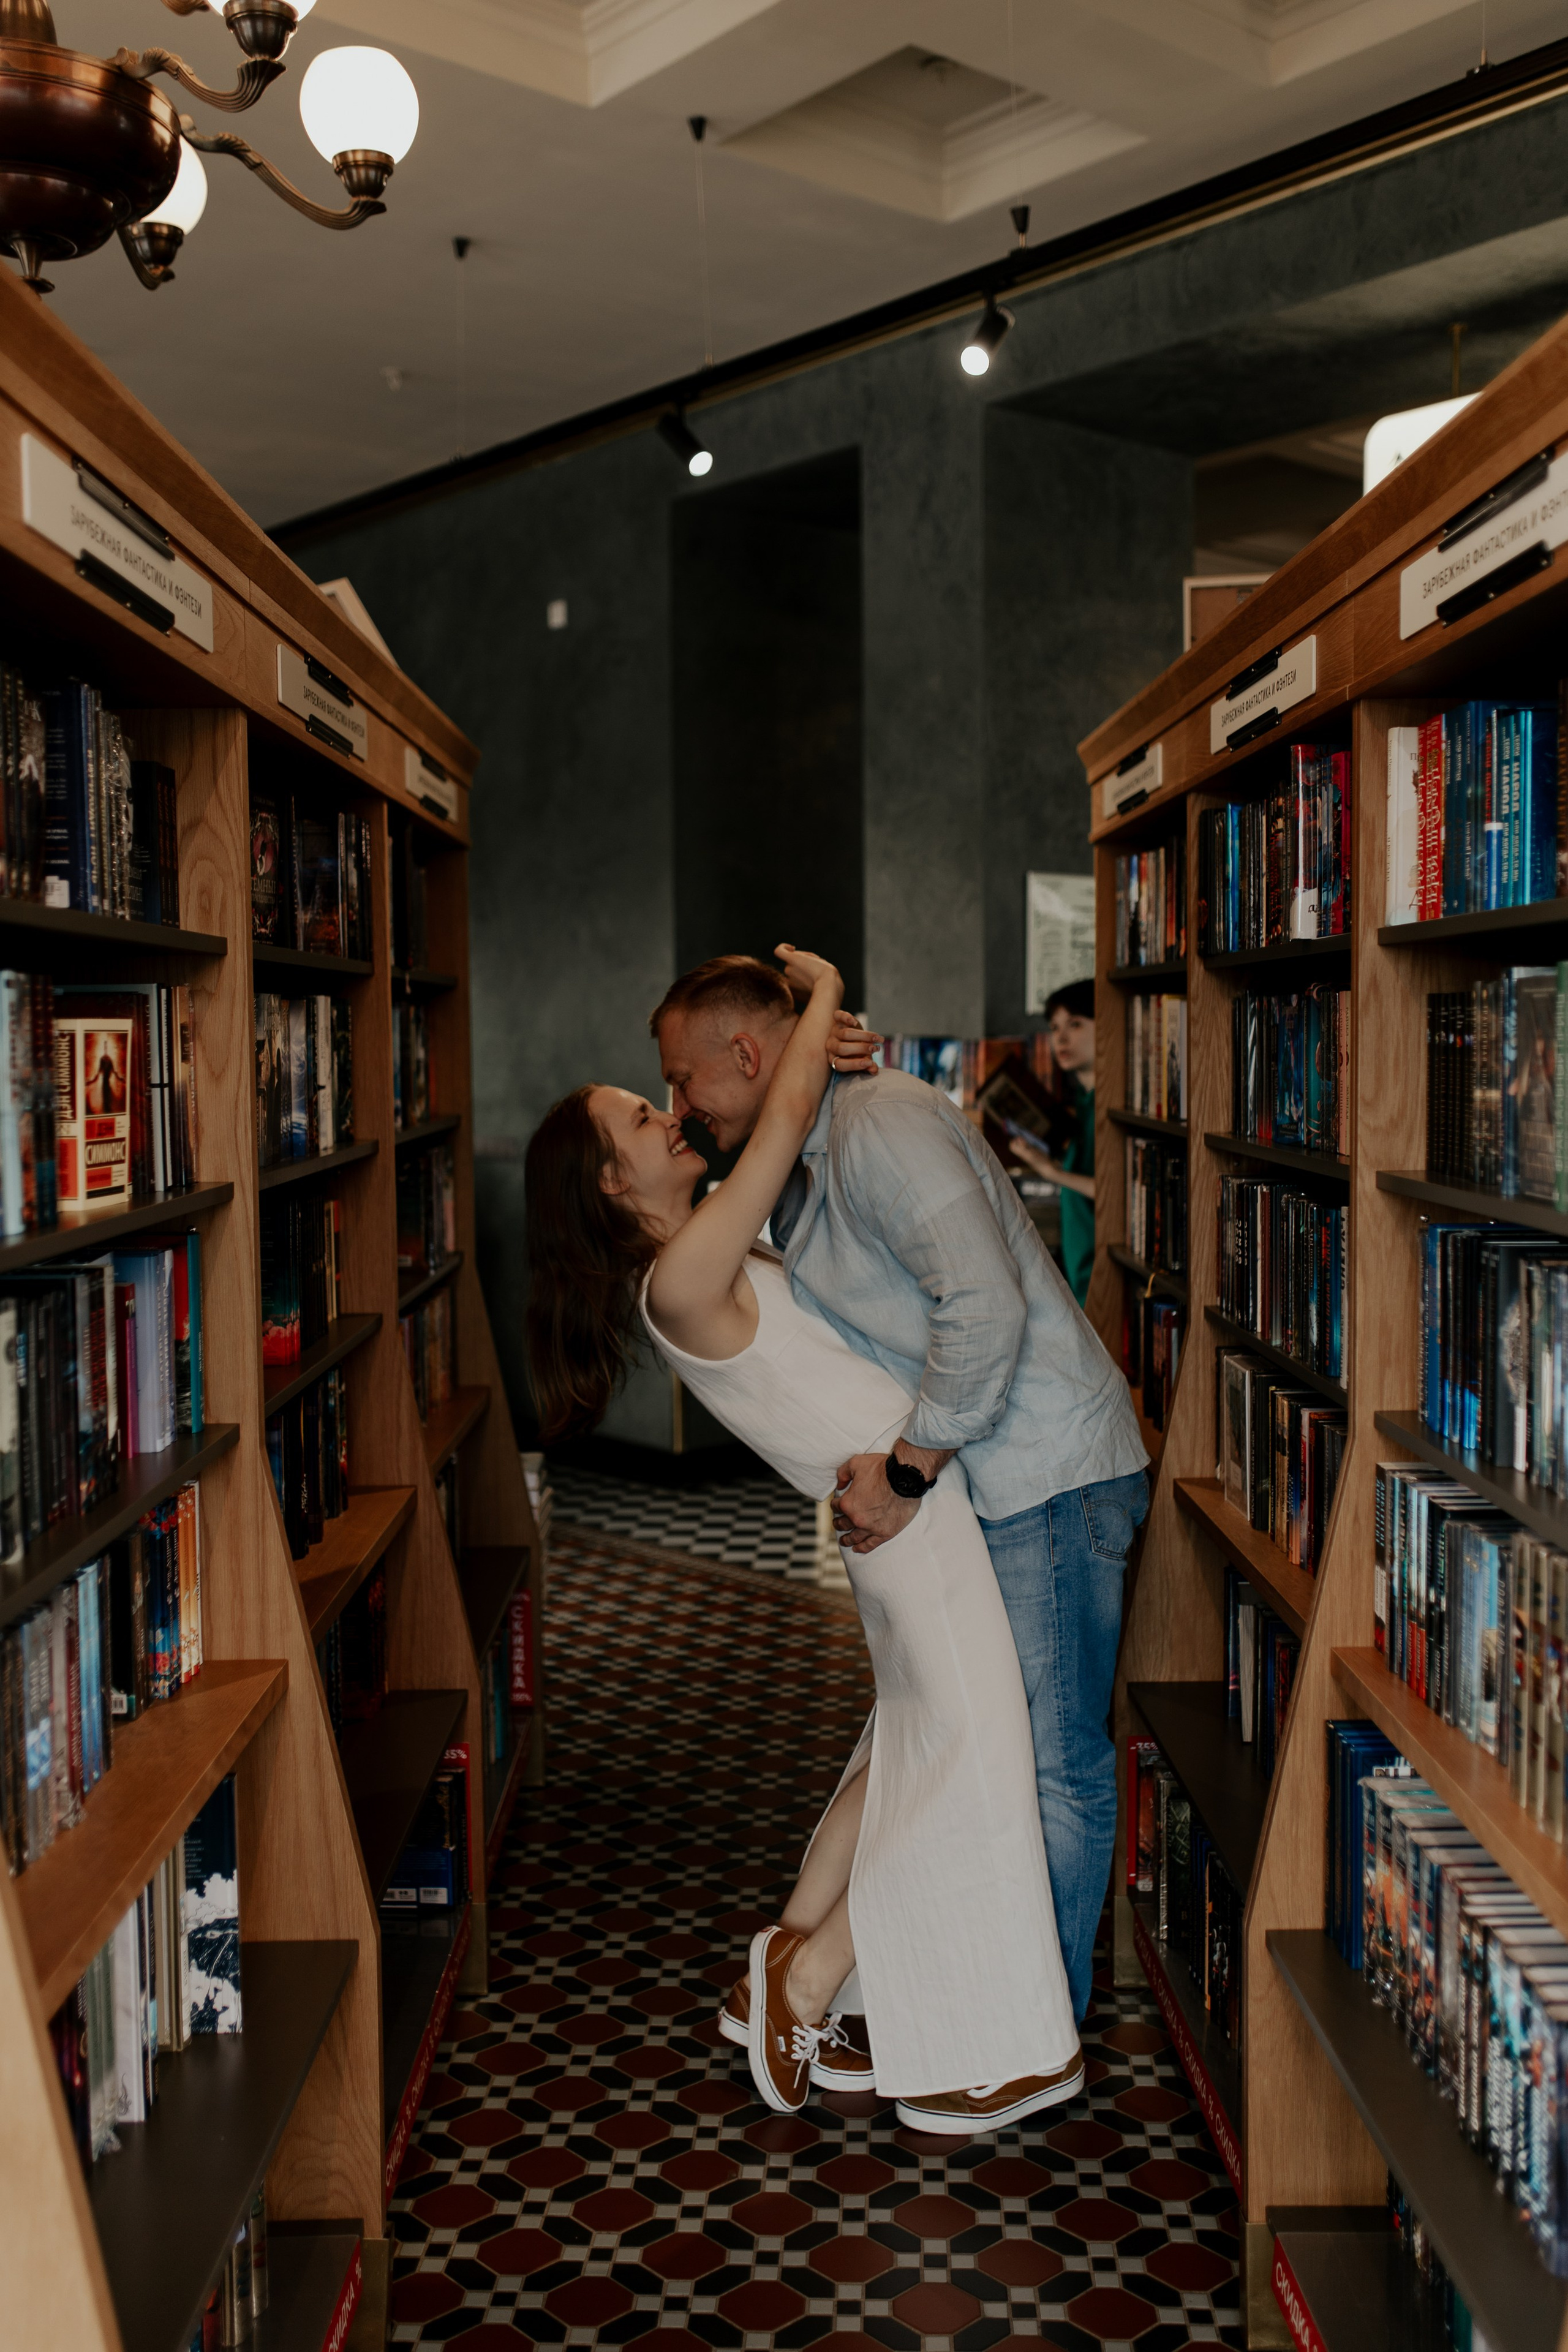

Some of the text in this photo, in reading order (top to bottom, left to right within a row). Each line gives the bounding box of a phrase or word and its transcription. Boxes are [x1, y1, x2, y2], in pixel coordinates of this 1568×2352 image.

[70, 503, 202, 619] ЗАРУБЕЖНАЯ ФАНТАСТИКА И ФЭНТЕЗИ
[1423, 553, 1470, 599] ЗАРУБЕЖНАЯ
[1473, 516, 1528, 564] ФАНТАСТИКА
[1531, 510, 1537, 529] И
[1221, 669, 1297, 728] ЗАРУБЕЖНАЯ ФАНТАСТИКА И ФЭНТЕЗИ
[54, 1035, 72, 1093] СИММОНС
[55, 1095, 74, 1120] ДЭН
[85, 1141, 126, 1165] СИММОНС
[510, 1604, 526, 1689] СКИДКА
[385, 2118, 406, 2187] СКИДКА
[411, 2046, 429, 2108] СКИДКА
[1157, 1978, 1177, 2035] СКИДКА
[1185, 2041, 1207, 2106] СКИДКА
[1208, 2094, 1214, 2121] %
[1215, 2113, 1241, 2185] СКИДКА
[355, 2256, 363, 2287] %
[1276, 2261, 1310, 2352] СКИДКА
